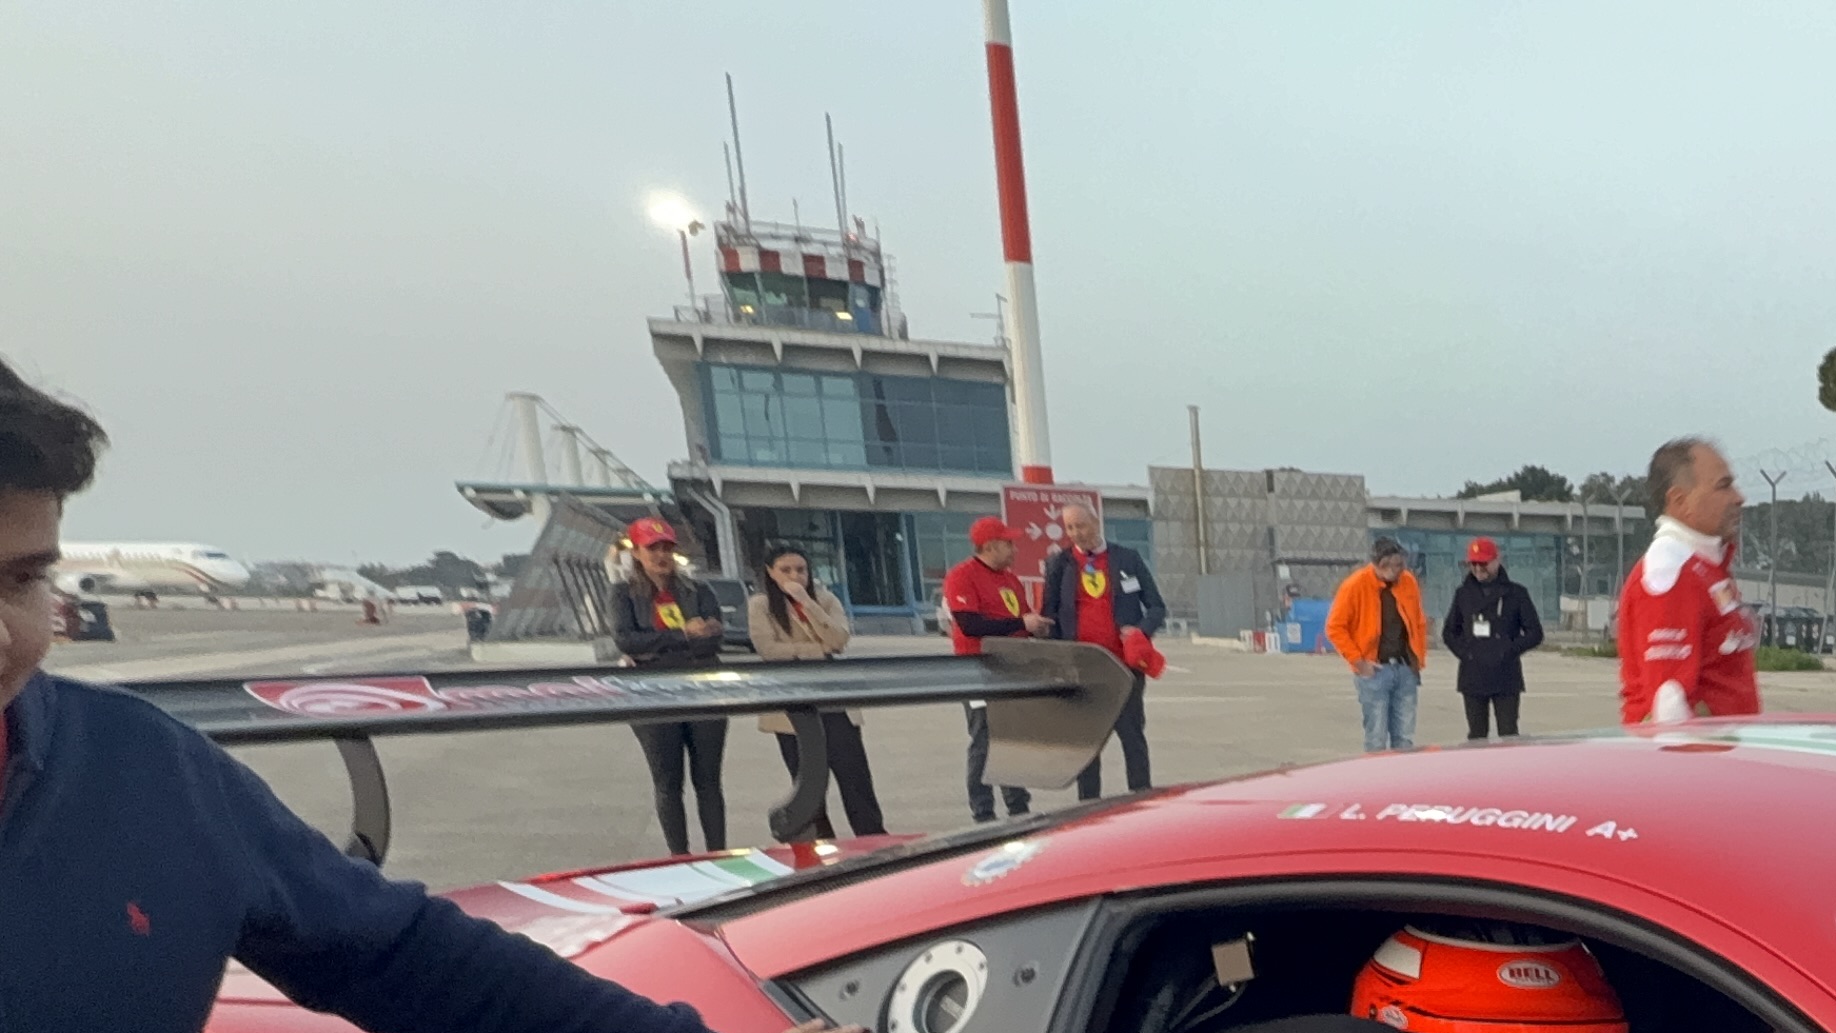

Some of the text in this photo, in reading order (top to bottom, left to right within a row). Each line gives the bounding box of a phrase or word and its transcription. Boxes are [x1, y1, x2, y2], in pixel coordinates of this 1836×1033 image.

[1339, 803, 1366, 820] L.
[1585, 820, 1639, 841] A+
[1508, 967, 1556, 981] BELL
